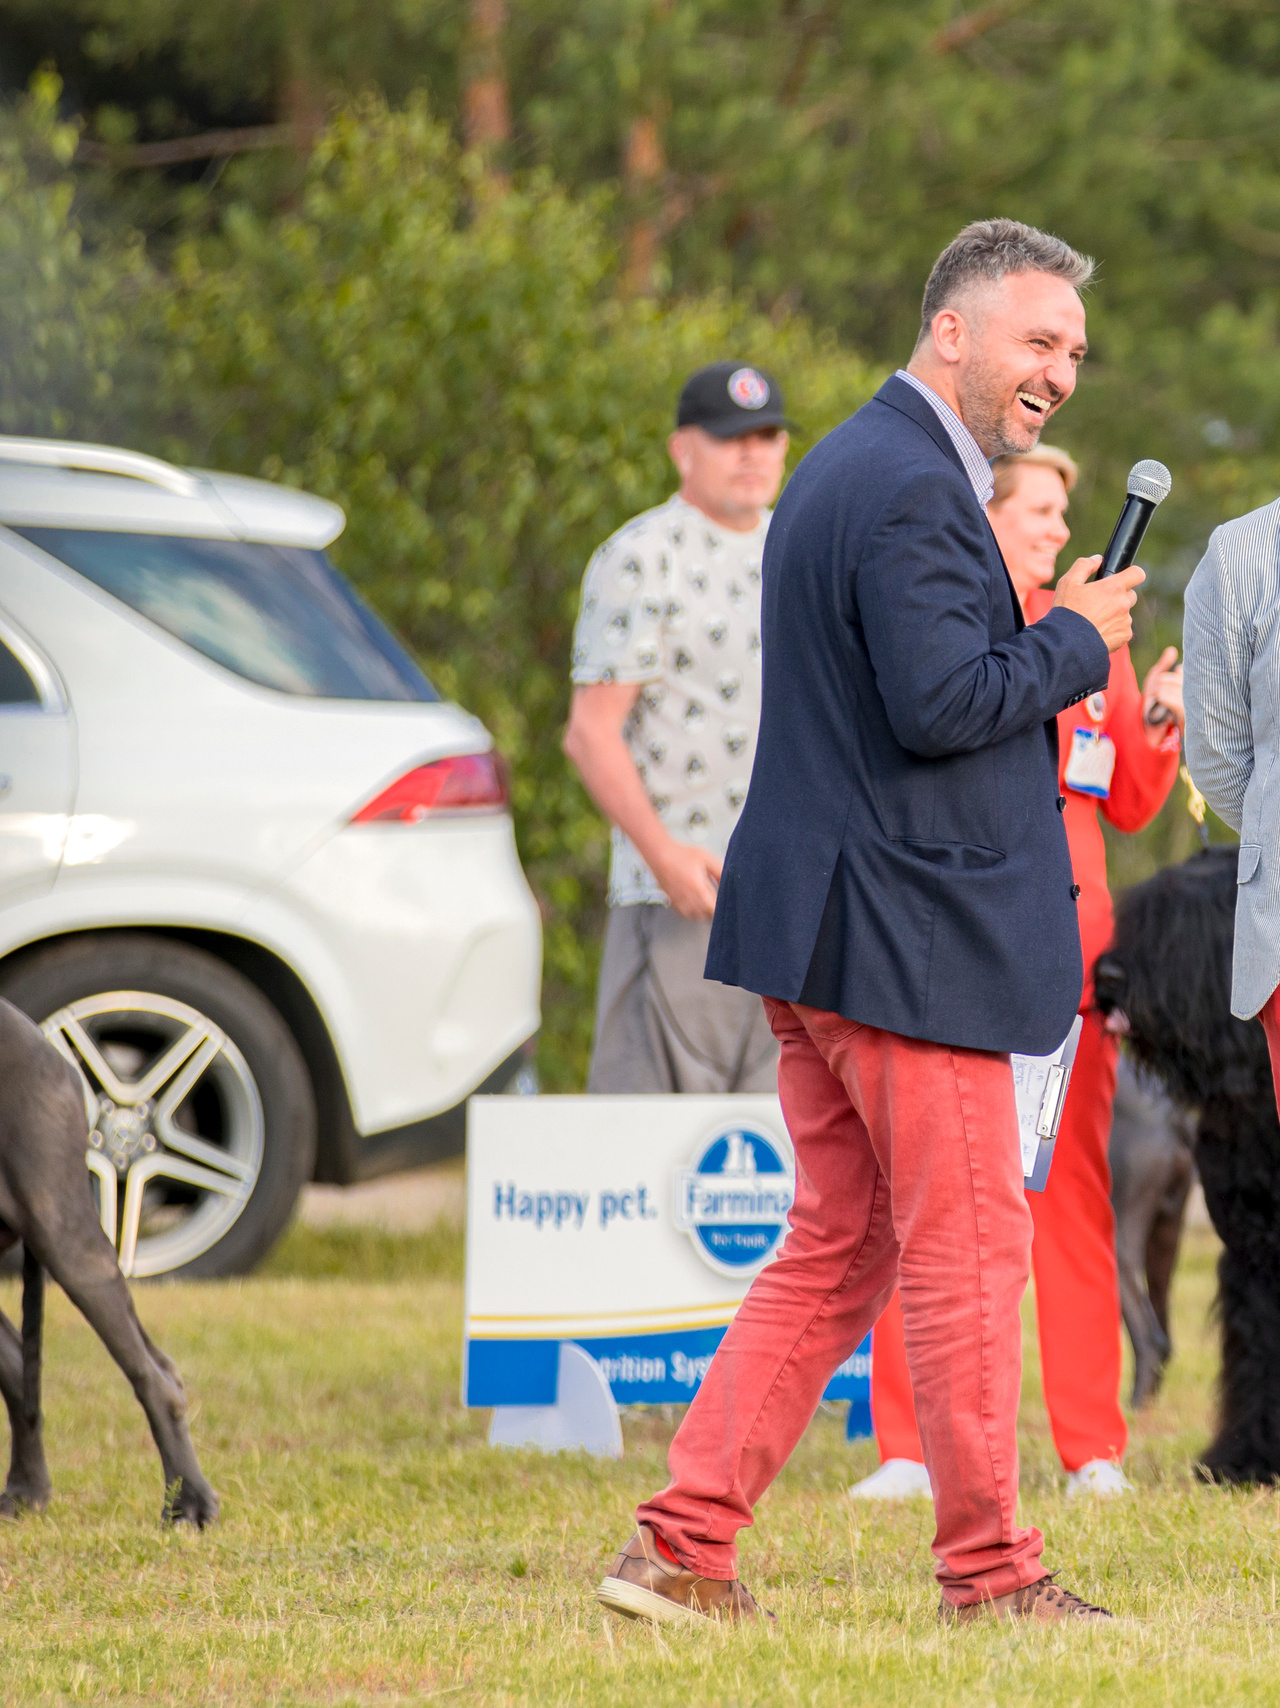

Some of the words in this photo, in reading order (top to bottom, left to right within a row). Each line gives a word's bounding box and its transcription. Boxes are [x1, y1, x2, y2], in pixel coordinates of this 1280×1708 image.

[493, 1180, 590, 1232] Happy
[599, 1182, 659, 1232] pet.
[686, 1182, 793, 1215] Farmina
